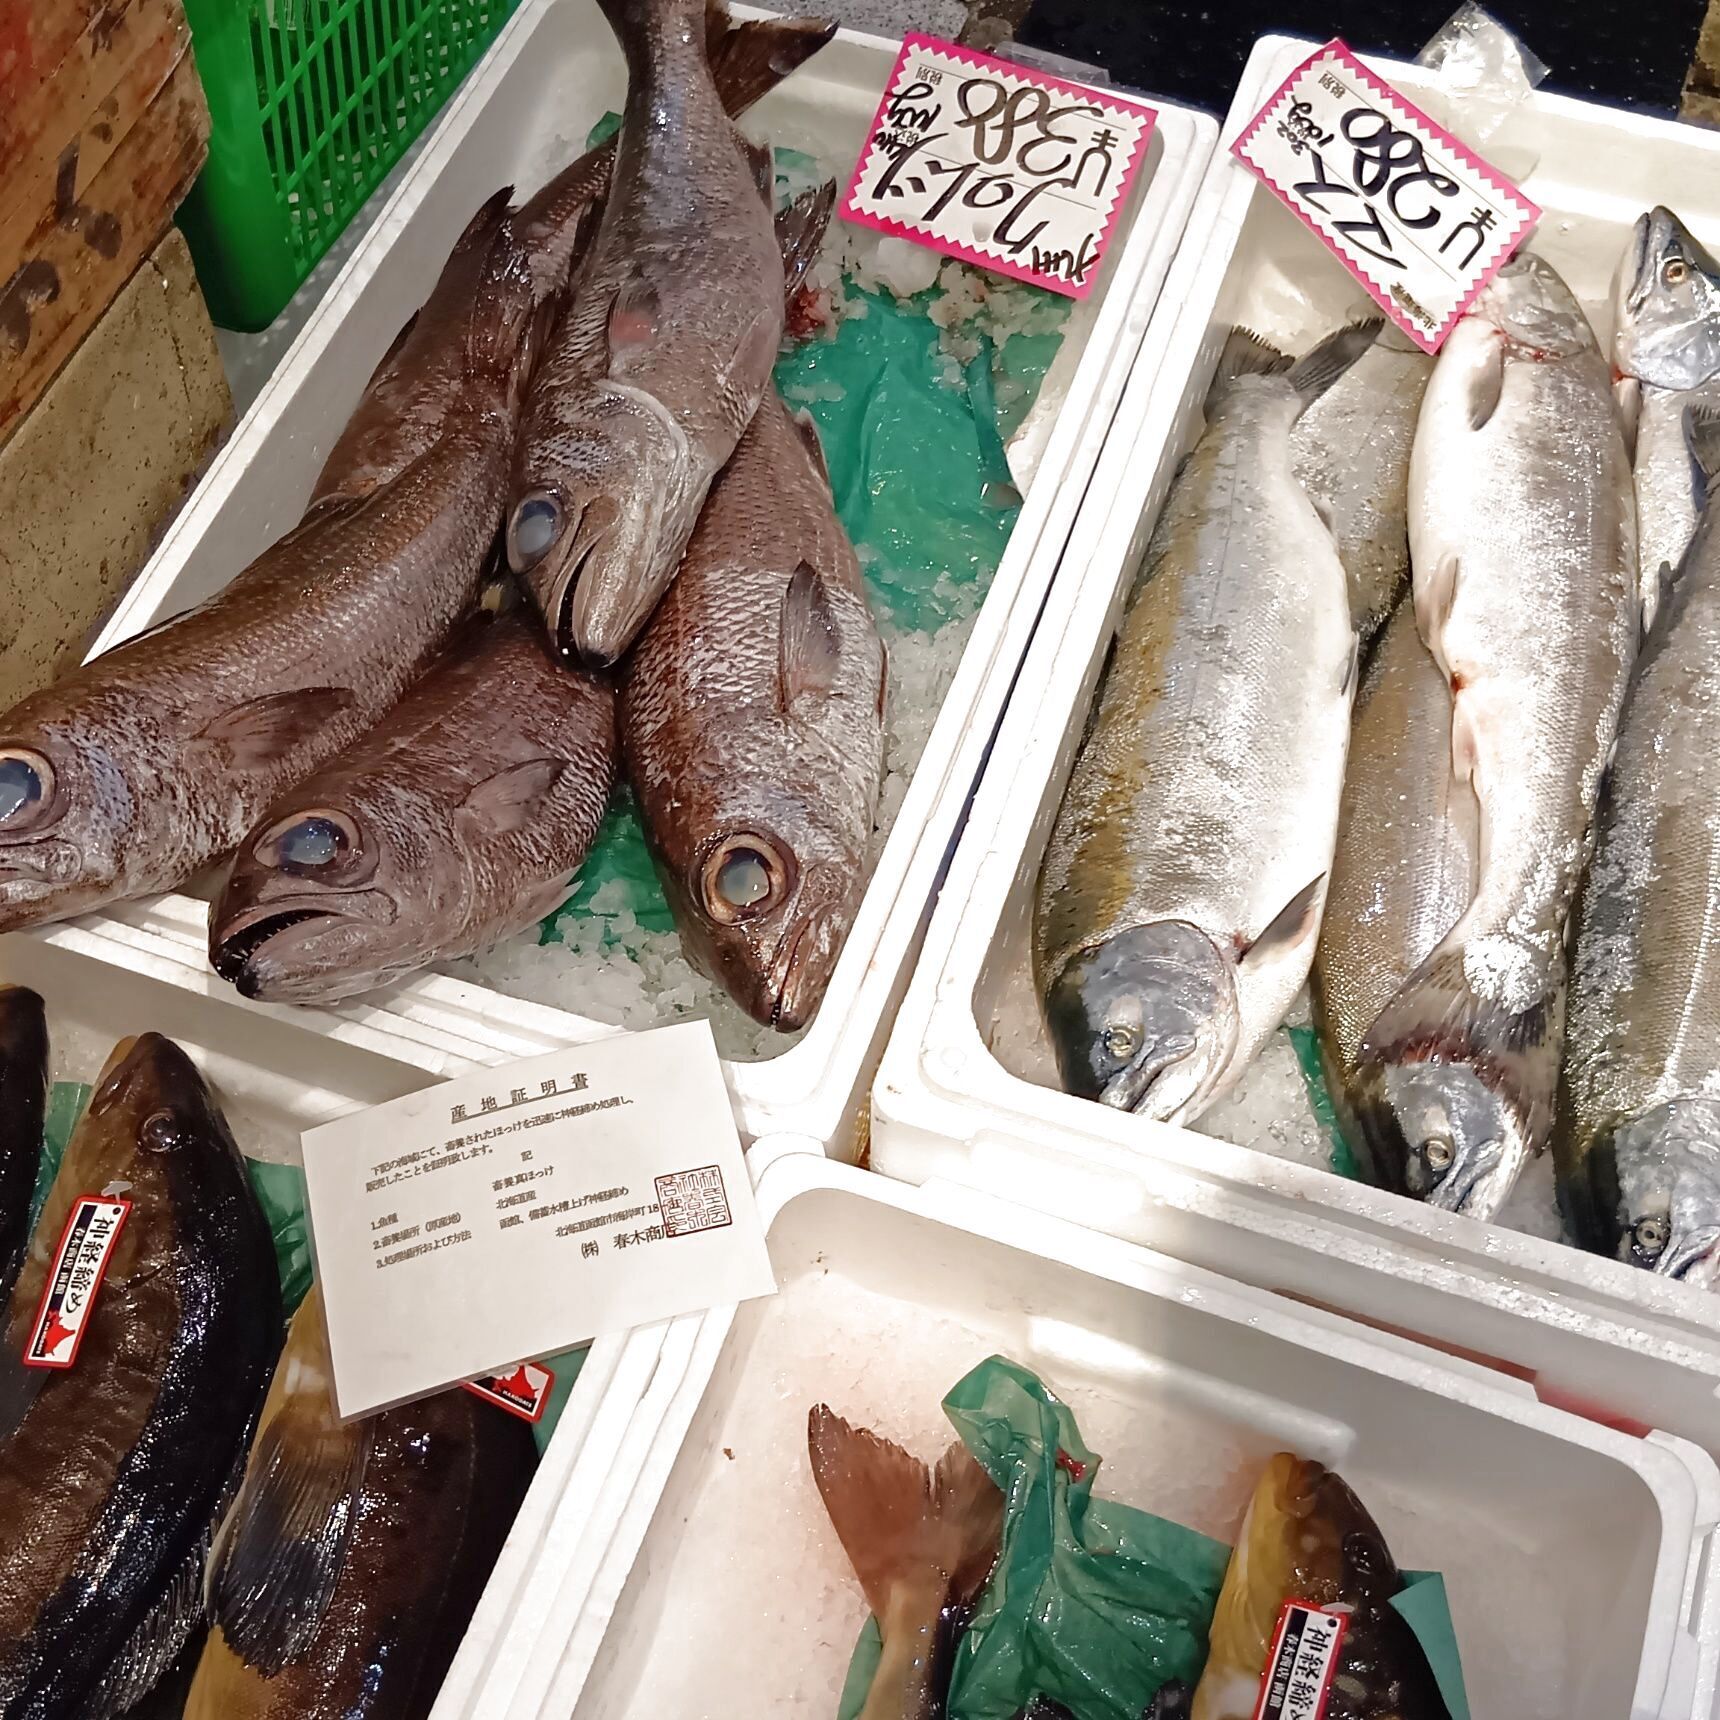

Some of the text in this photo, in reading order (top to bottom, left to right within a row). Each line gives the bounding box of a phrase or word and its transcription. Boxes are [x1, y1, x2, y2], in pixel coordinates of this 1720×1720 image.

[1293, 149, 1408, 270] マス
[65, 1216, 115, 1314] 神経締め
